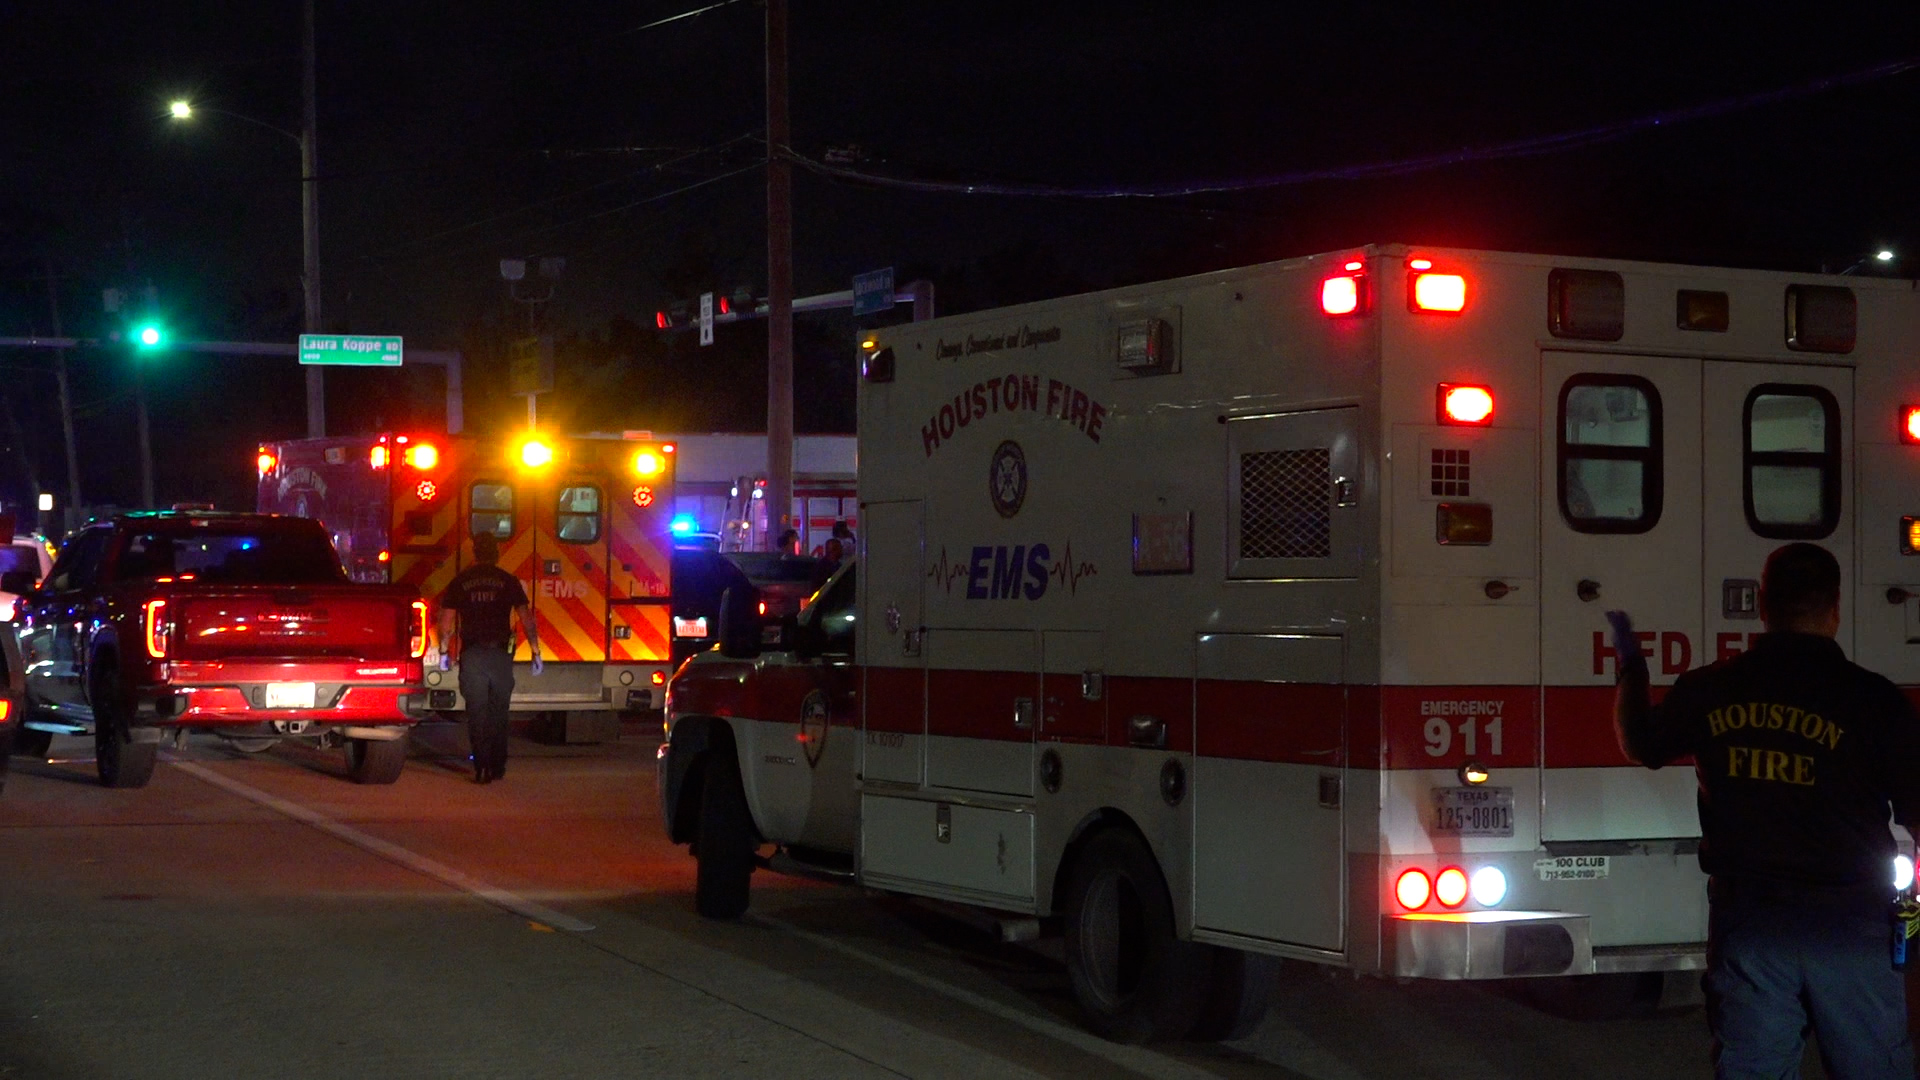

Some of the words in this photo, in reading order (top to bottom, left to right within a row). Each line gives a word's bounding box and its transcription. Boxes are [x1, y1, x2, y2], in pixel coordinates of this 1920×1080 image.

[303, 337, 337, 350] Laura
[343, 338, 381, 352] Koppe
[921, 373, 1039, 458] HOUSTON
[1047, 378, 1106, 444] FIRE
[966, 543, 1050, 600] EMS
[541, 580, 589, 599] EMS
[1421, 700, 1504, 716] EMERGENCY
[1423, 716, 1503, 757] 911
[1706, 702, 1845, 750] HOUSTON
[1727, 745, 1816, 786] FIRE
[1457, 791, 1489, 801] TEXAS
[1555, 858, 1573, 867] 100
[1576, 857, 1605, 867] CLUB
